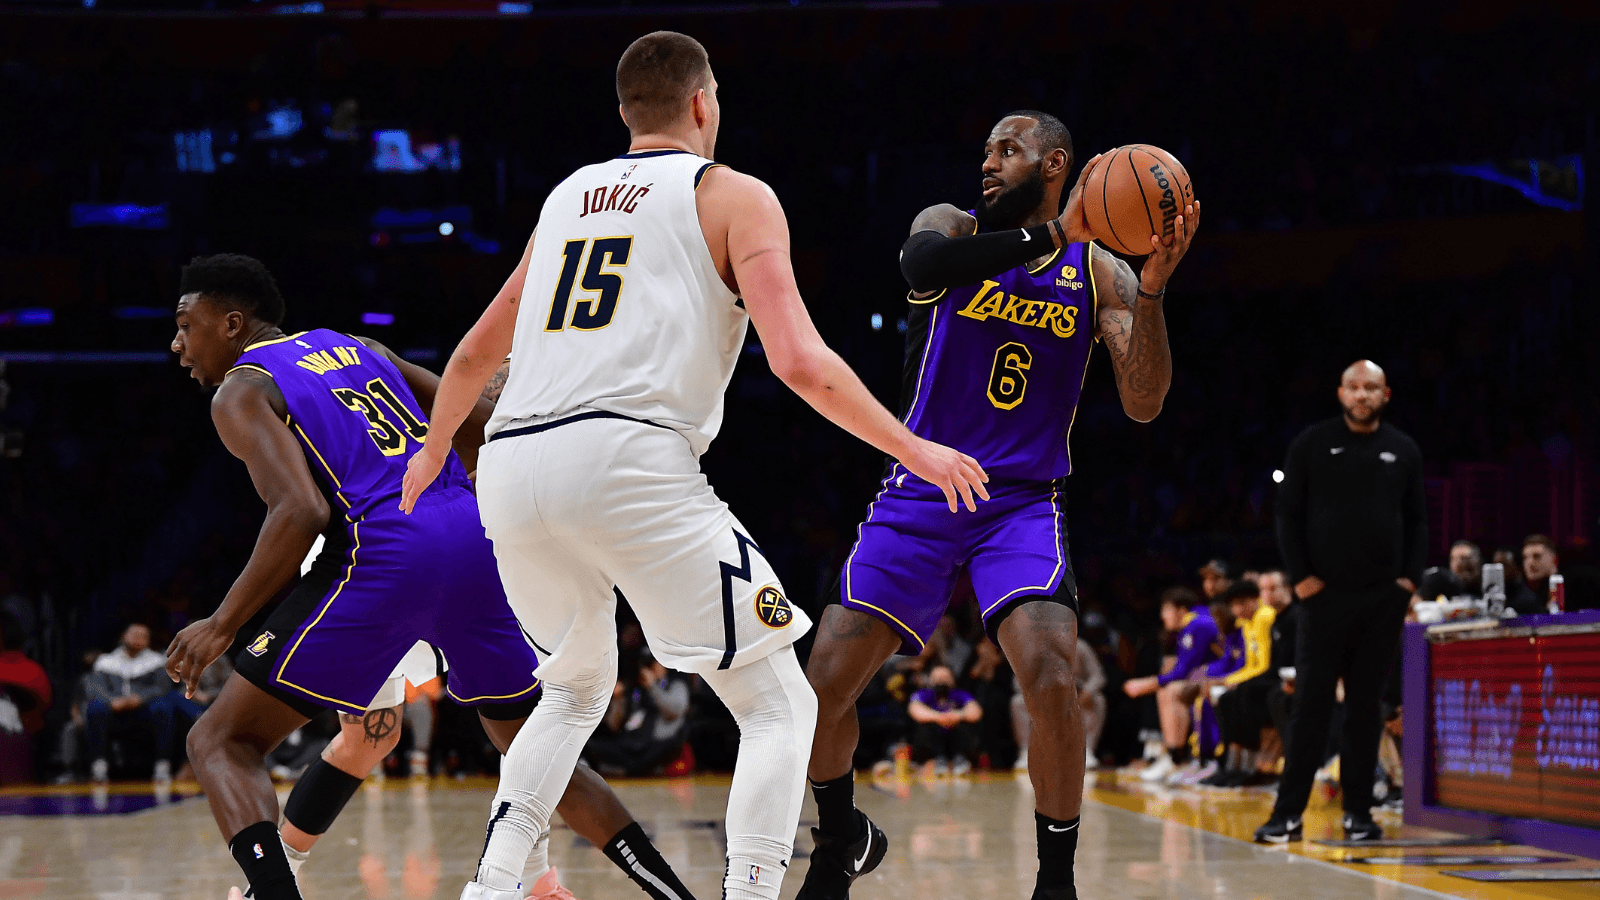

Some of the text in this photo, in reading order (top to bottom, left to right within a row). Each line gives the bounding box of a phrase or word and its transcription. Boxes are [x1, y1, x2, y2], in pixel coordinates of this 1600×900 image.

[580, 183, 654, 218] JOKIĆ
[1150, 164, 1178, 238] Wilson
[544, 235, 634, 332] 15
[956, 279, 1079, 339] LAKERS
[1055, 277, 1083, 291] bibigo
[986, 341, 1032, 411] 6
[331, 377, 429, 457] 31
